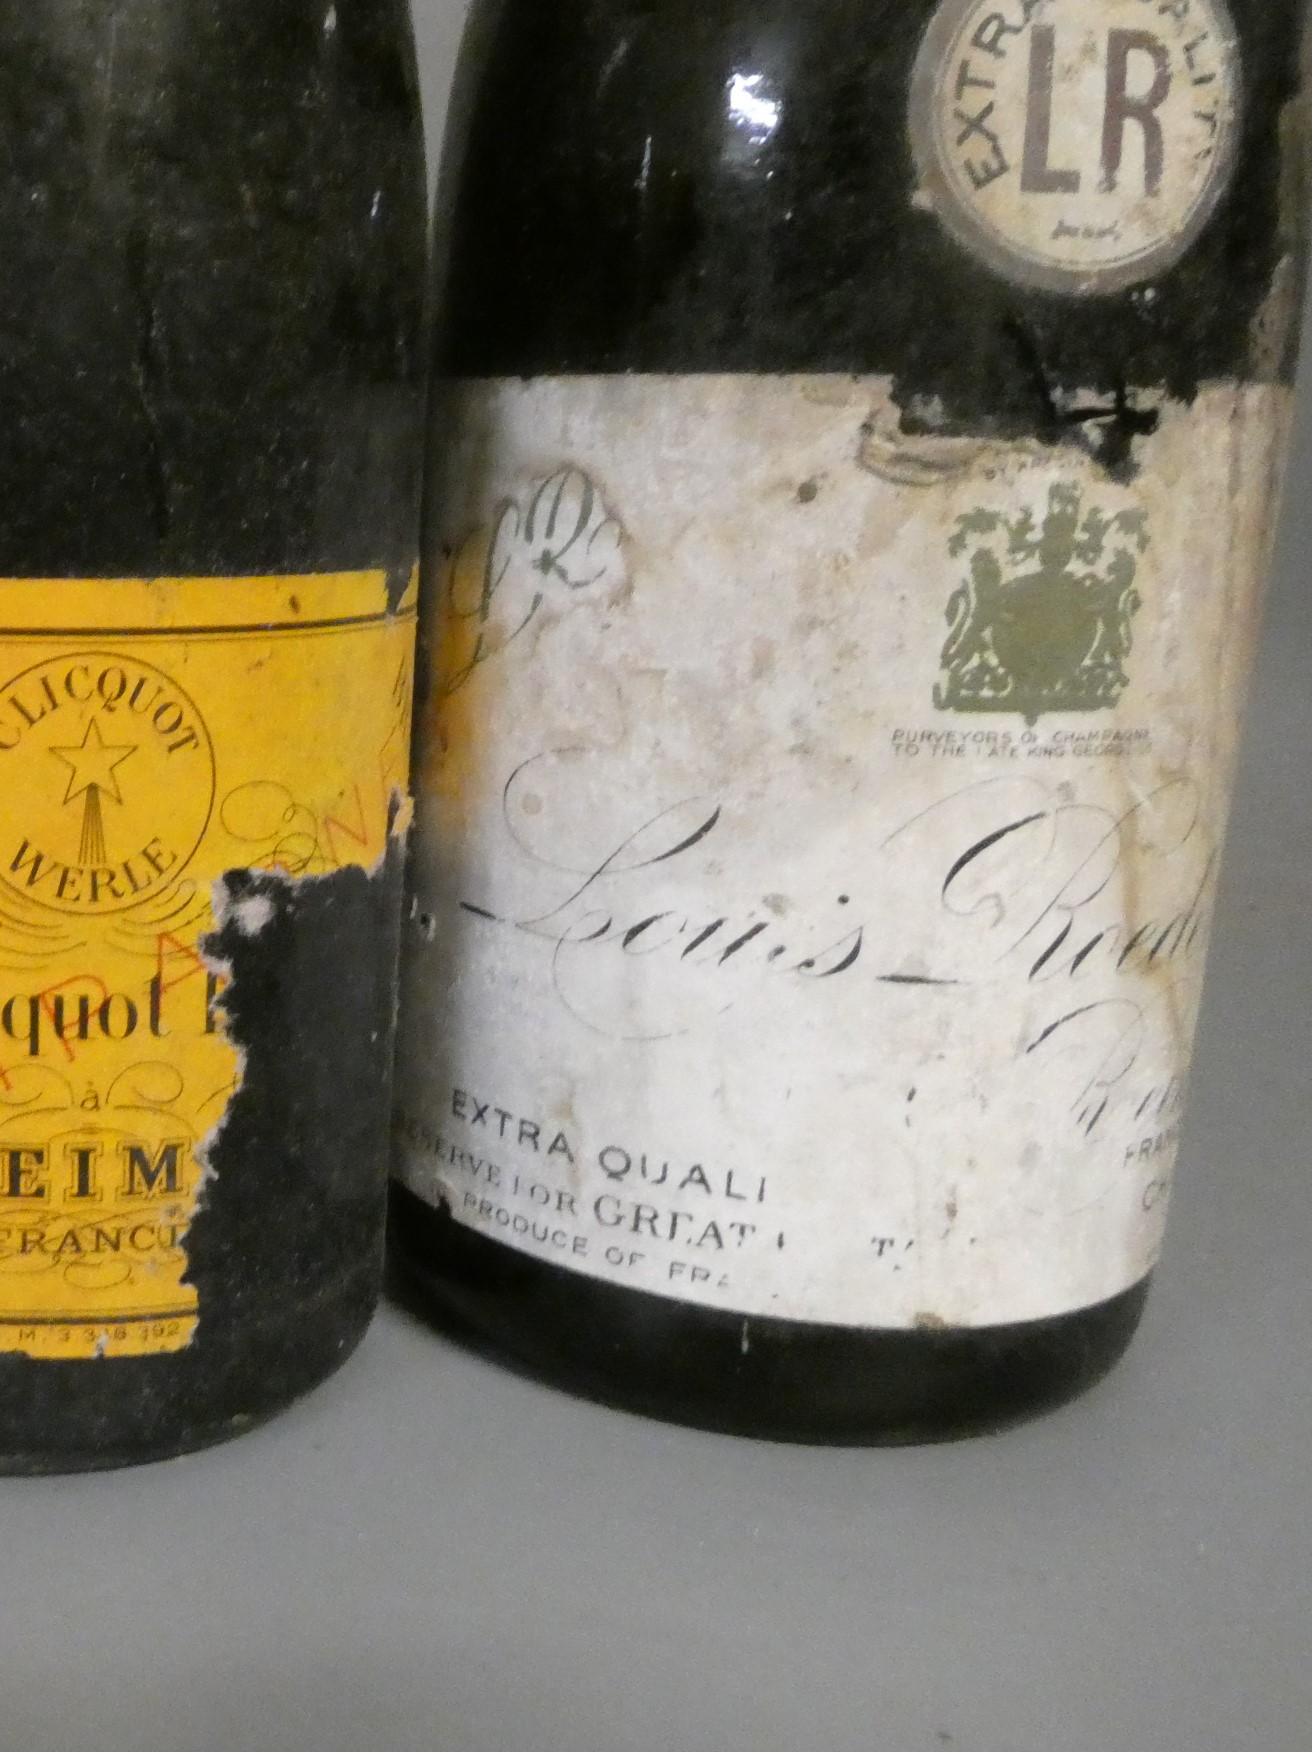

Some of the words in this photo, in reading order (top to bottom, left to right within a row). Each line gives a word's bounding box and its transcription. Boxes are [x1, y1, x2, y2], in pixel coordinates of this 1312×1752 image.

[1019, 23, 1174, 198] LR
[892, 728, 1013, 744] PURVEYORS
[9, 835, 179, 903] WERLE
[79, 1079, 101, 1112] à
[451, 1088, 575, 1164] EXTRA
[463, 1191, 589, 1258] PRODUCE
